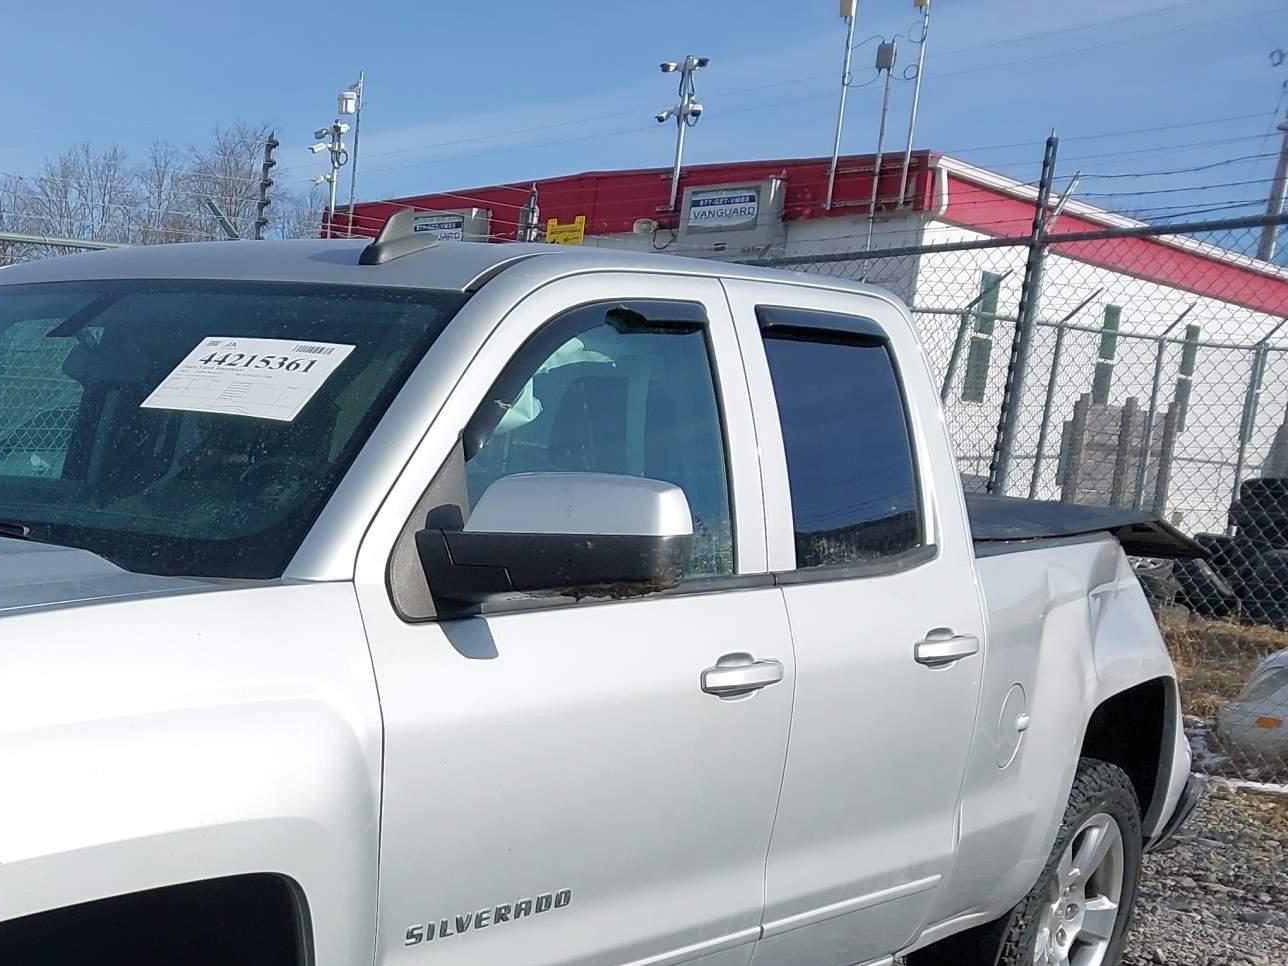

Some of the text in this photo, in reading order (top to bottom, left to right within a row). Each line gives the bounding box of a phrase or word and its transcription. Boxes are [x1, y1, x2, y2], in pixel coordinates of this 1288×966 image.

[693, 206, 756, 220] VANGUARD
[198, 351, 318, 374] 44215361
[405, 888, 573, 946] SILVERADO
